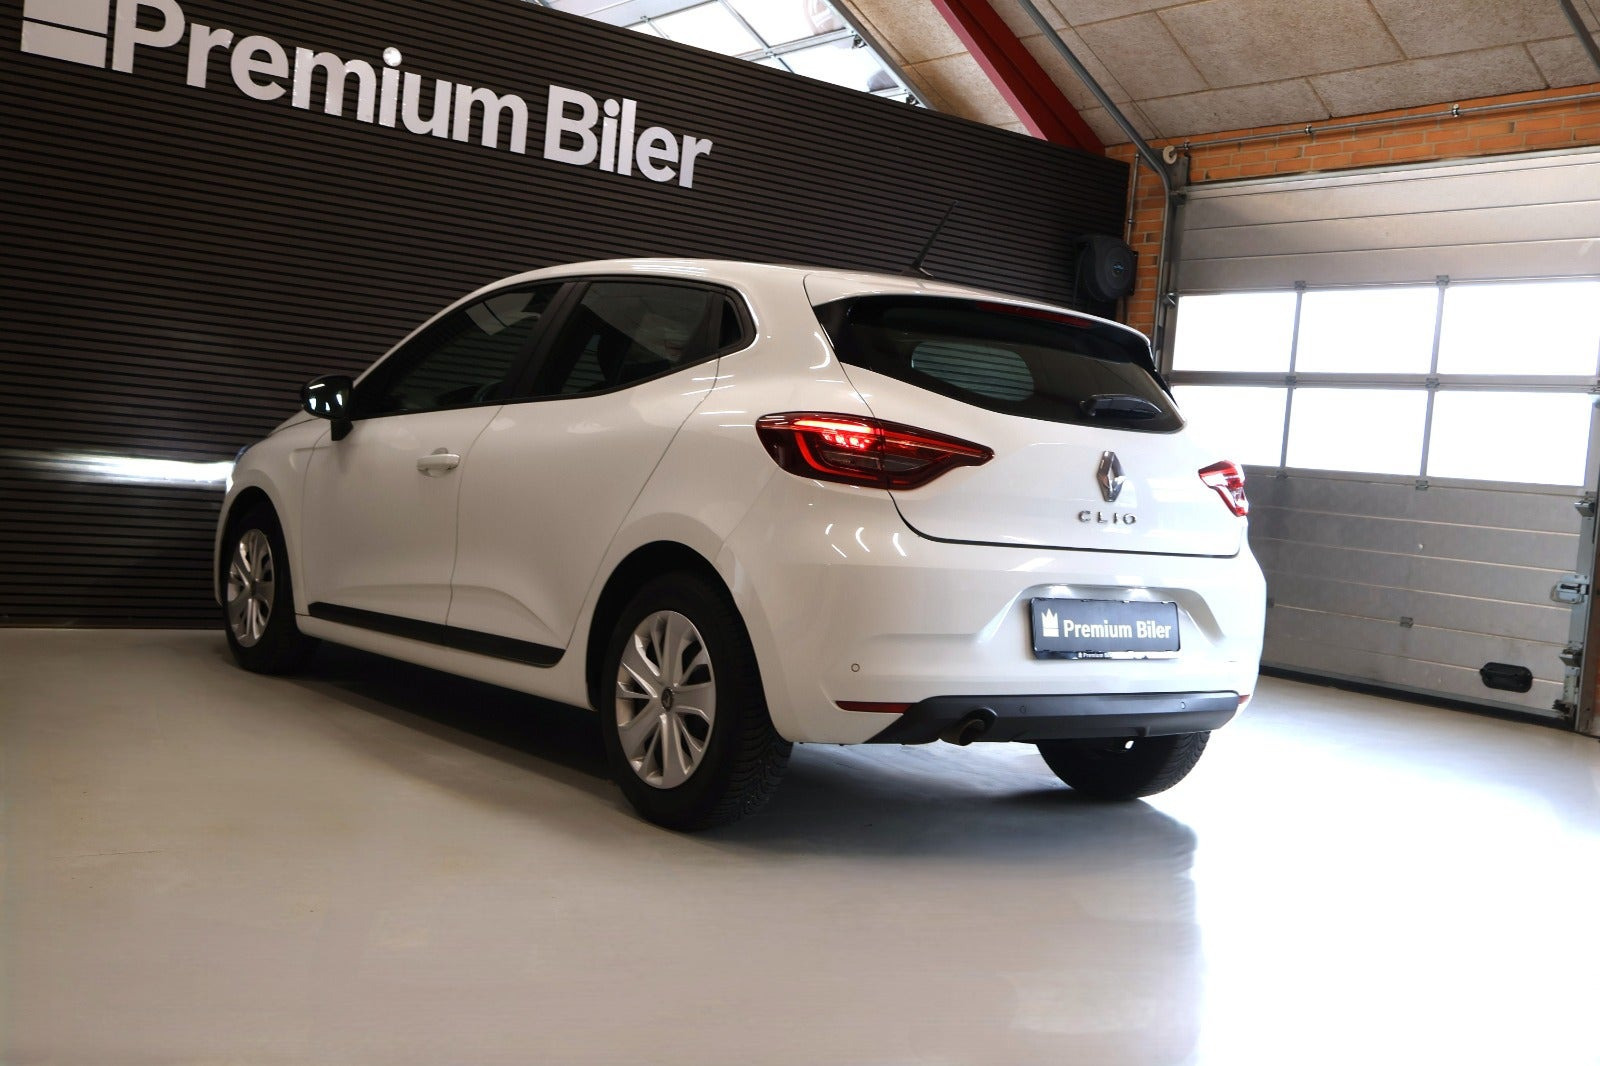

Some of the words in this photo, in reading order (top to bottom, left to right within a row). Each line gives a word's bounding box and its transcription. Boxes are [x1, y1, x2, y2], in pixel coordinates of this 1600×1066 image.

[112, 0, 529, 154] Premium
[545, 84, 713, 189] Biler
[1078, 510, 1136, 525] CLIO
[1063, 619, 1132, 638] Premium
[1136, 620, 1172, 639] Biler
